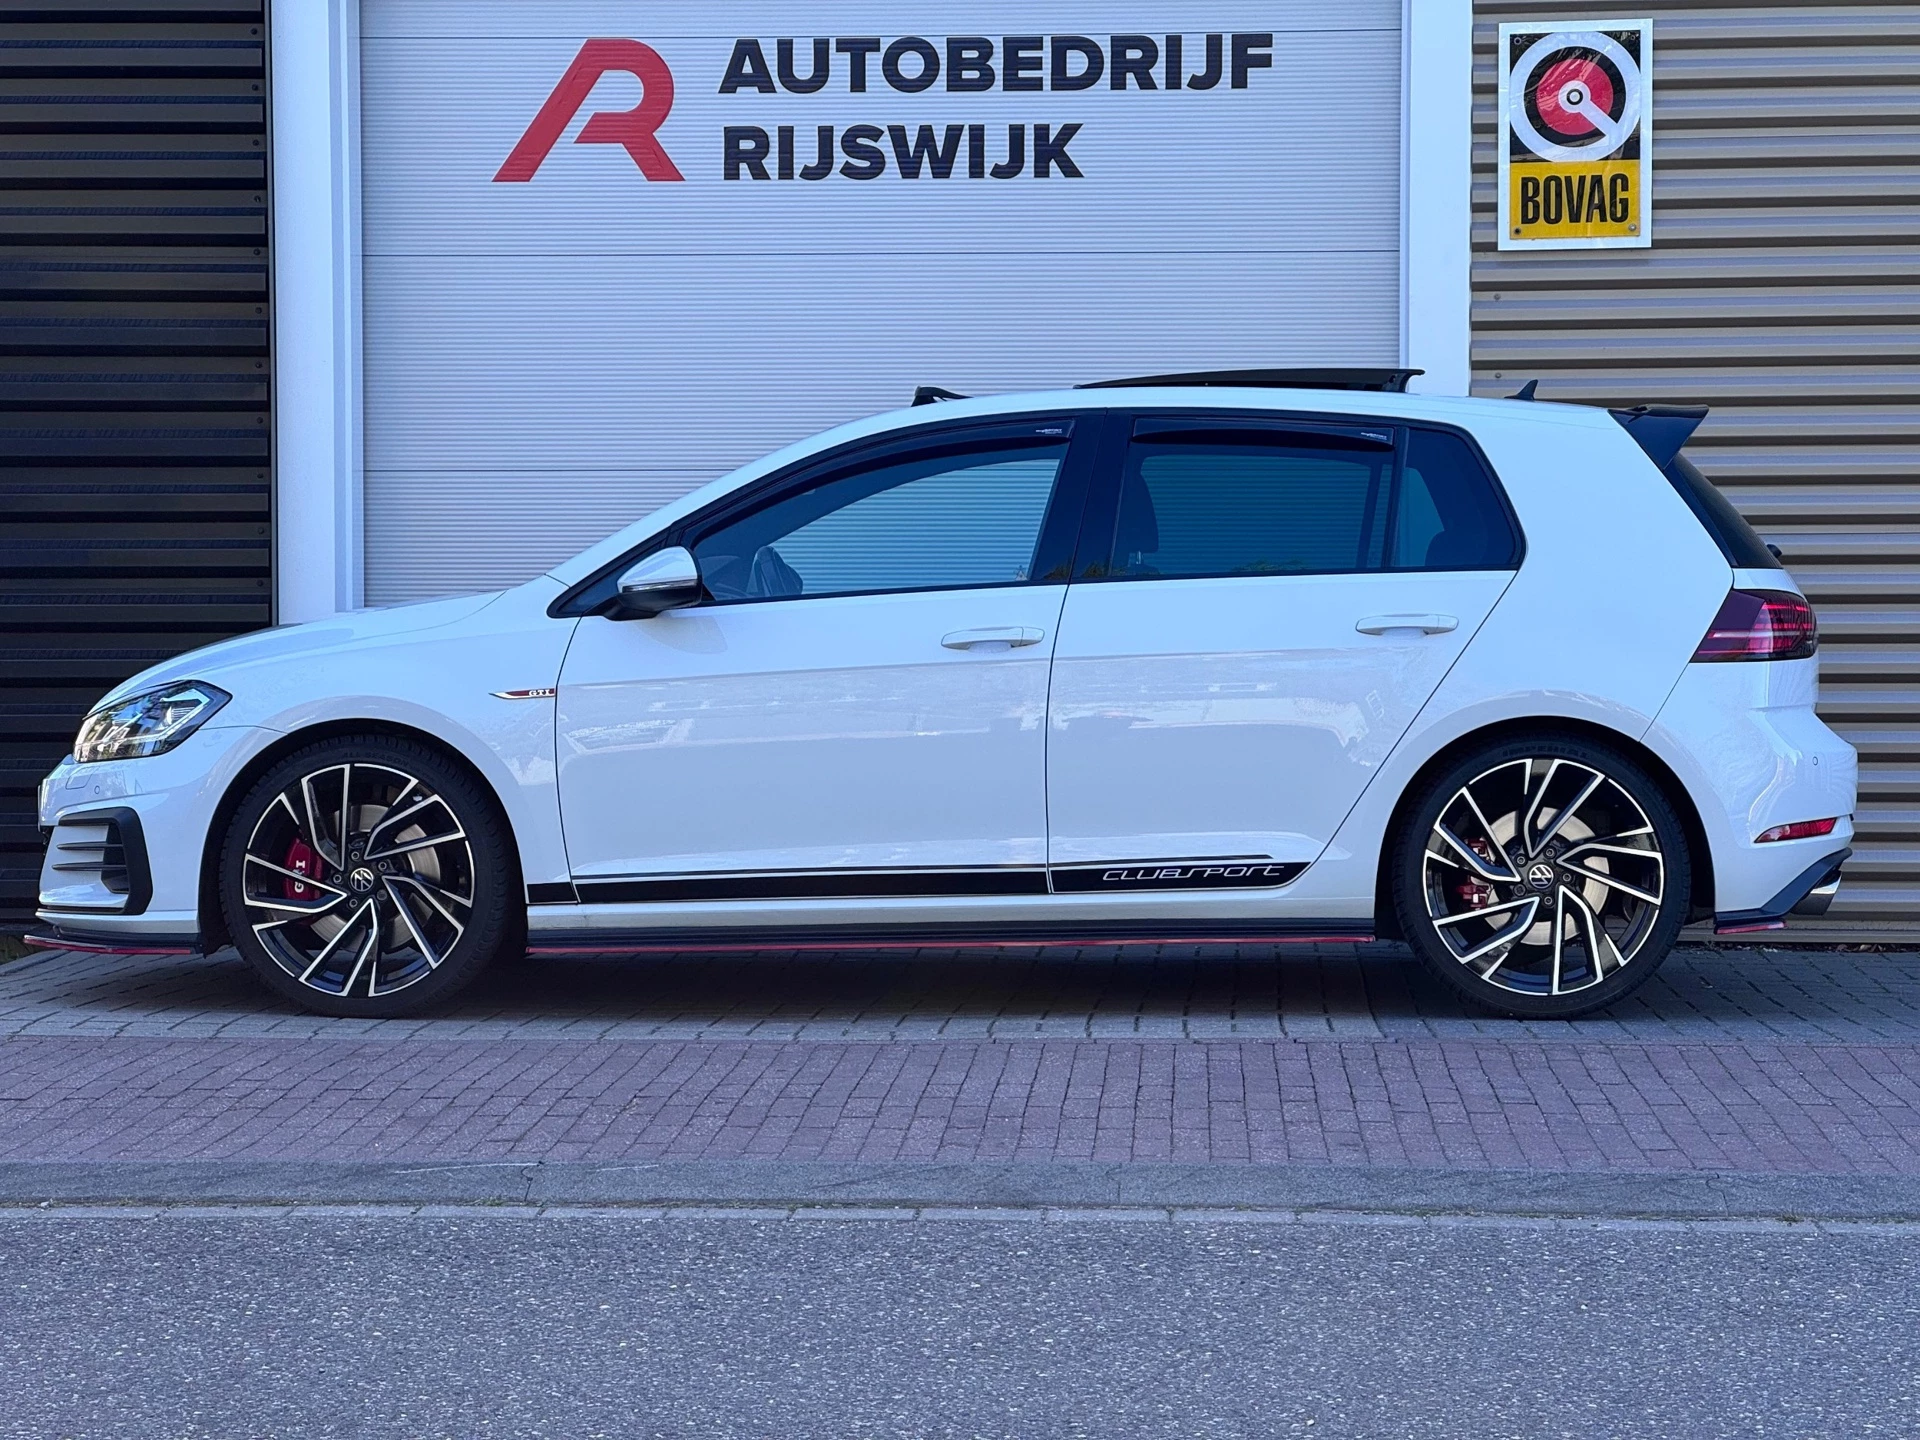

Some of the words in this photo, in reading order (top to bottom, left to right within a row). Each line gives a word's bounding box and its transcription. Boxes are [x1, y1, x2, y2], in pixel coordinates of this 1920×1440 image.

[718, 33, 1273, 93] AUTOBEDRIJF
[722, 123, 1084, 181] RIJSWIJK
[1520, 173, 1629, 224] BOVAG
